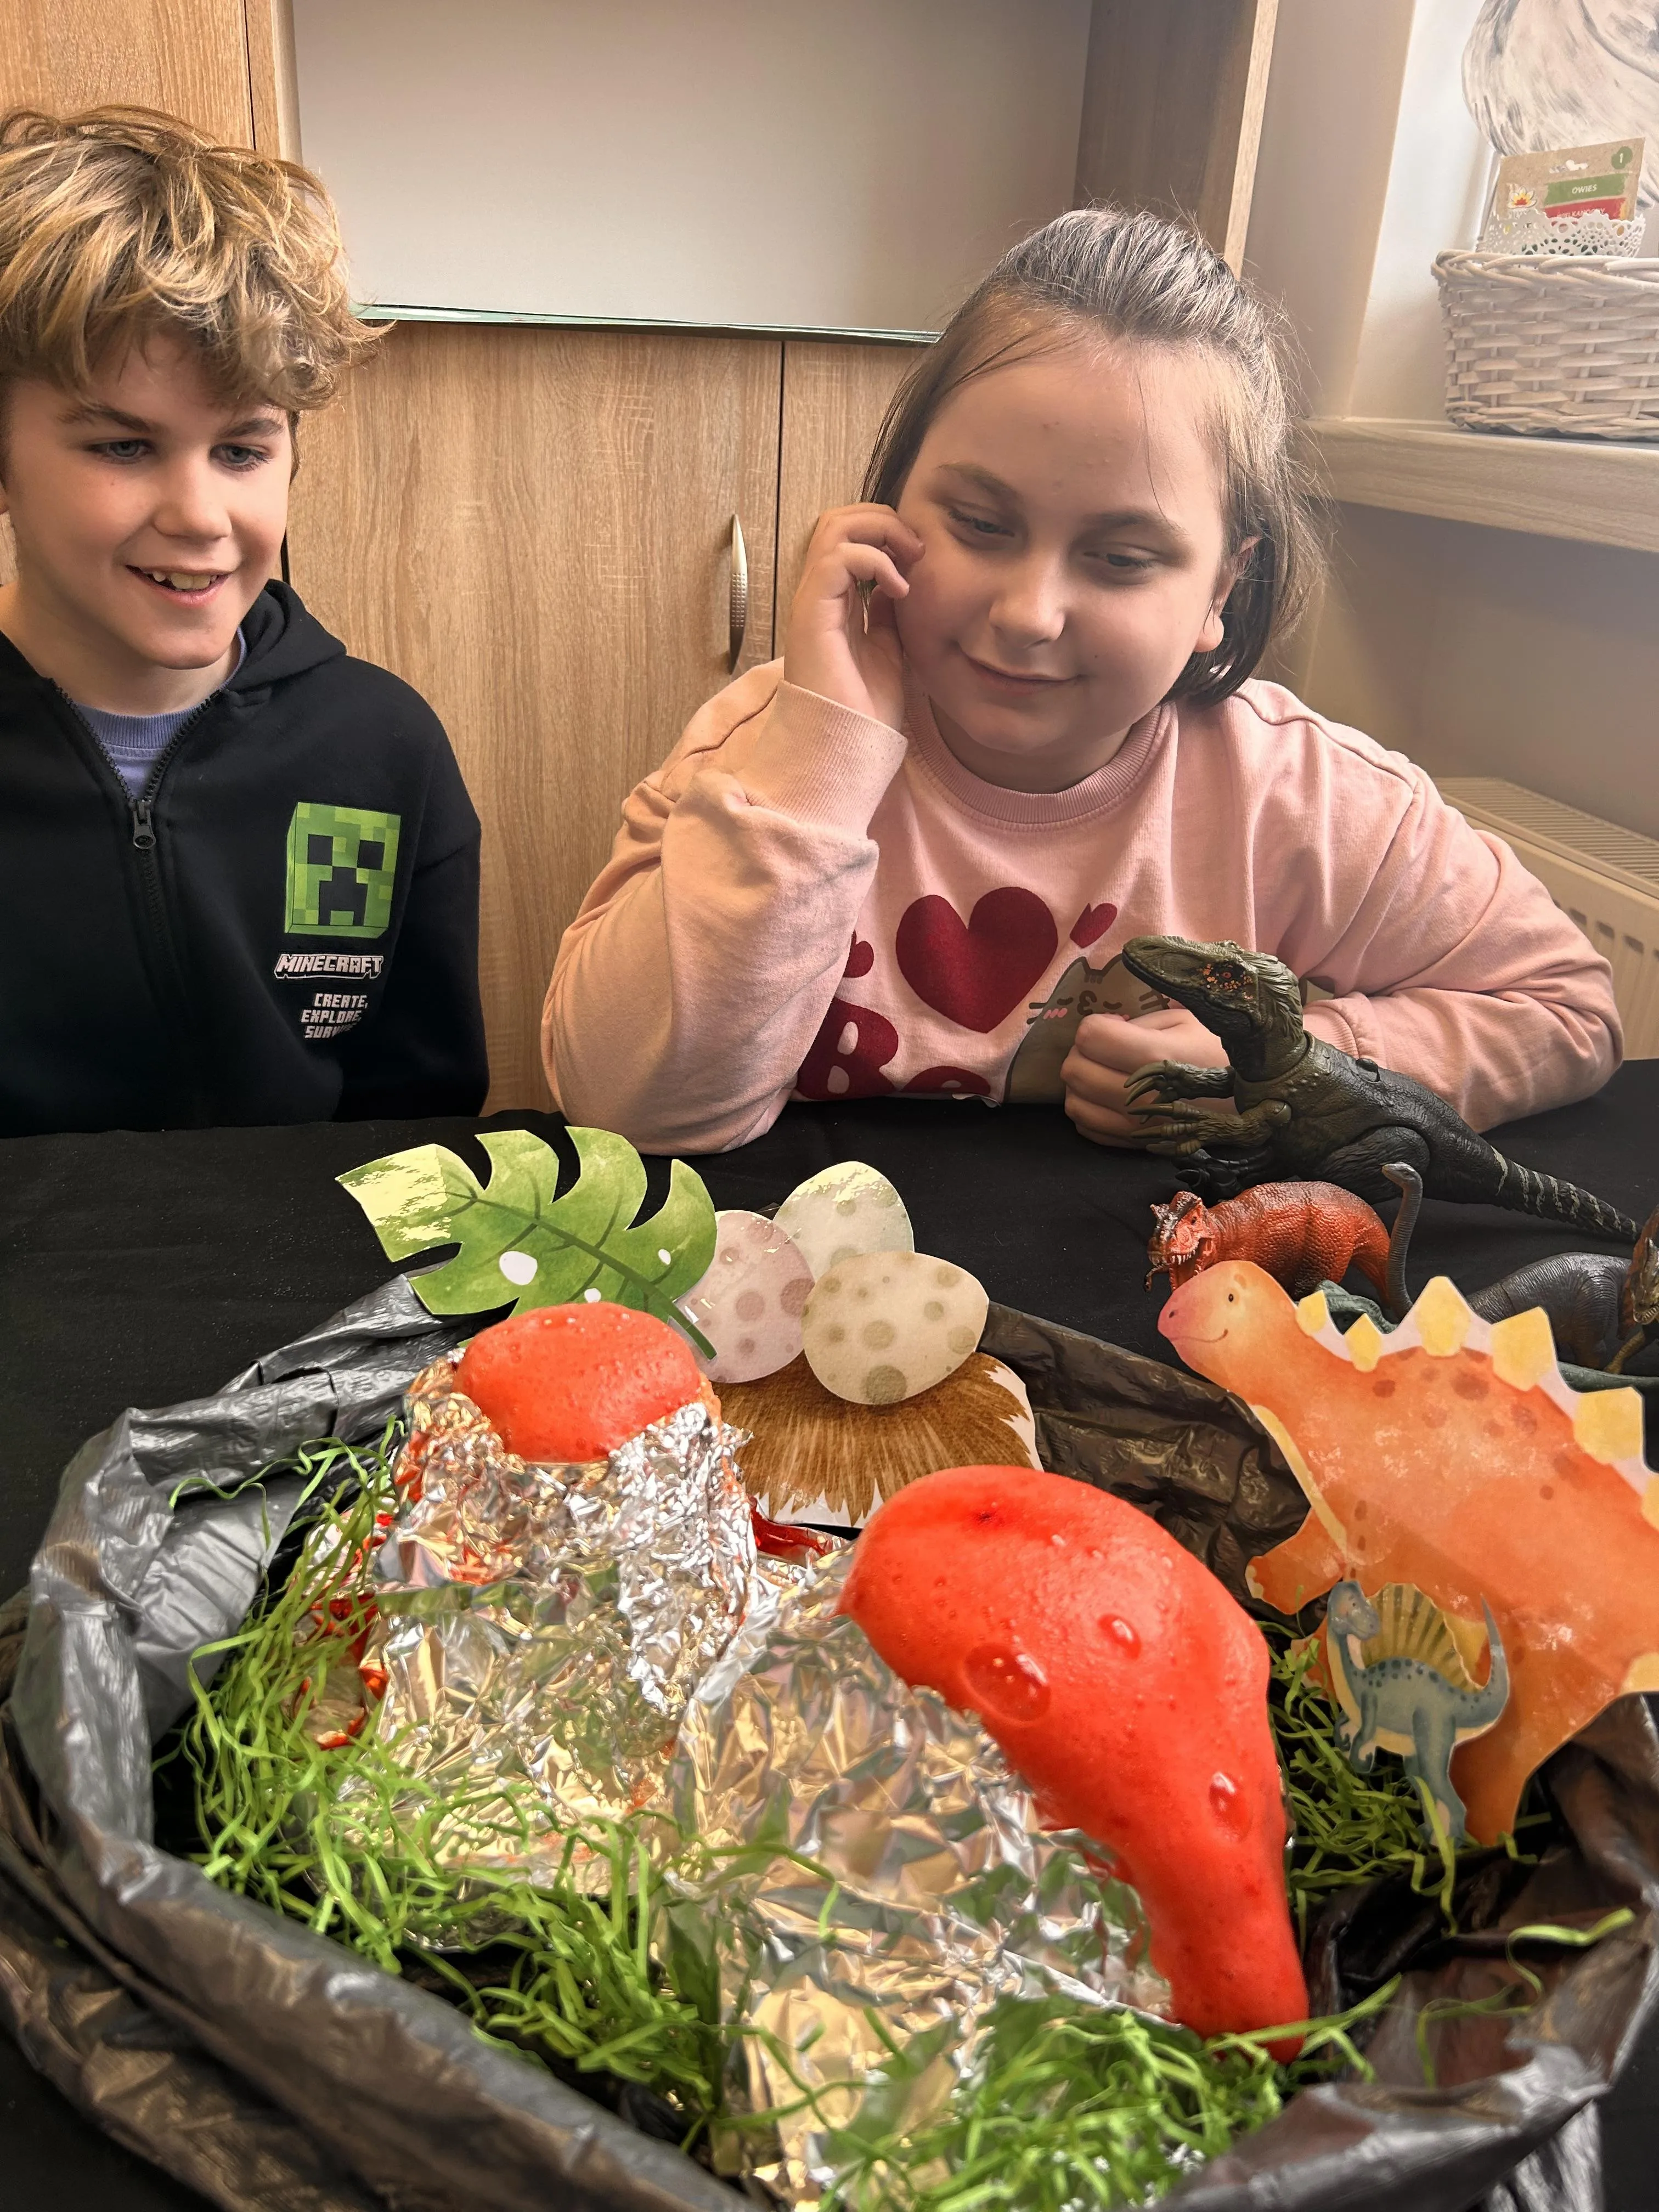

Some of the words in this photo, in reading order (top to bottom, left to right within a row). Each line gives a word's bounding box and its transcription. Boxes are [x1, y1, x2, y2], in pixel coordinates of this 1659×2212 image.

[1619, 153, 1624, 163] 1
[1572, 184, 1598, 194] OWIES
[275, 955, 383, 974] MINECRAFT
[314, 993, 368, 1009] CREATE,
[301, 1009, 362, 1024] EXPLORE,
